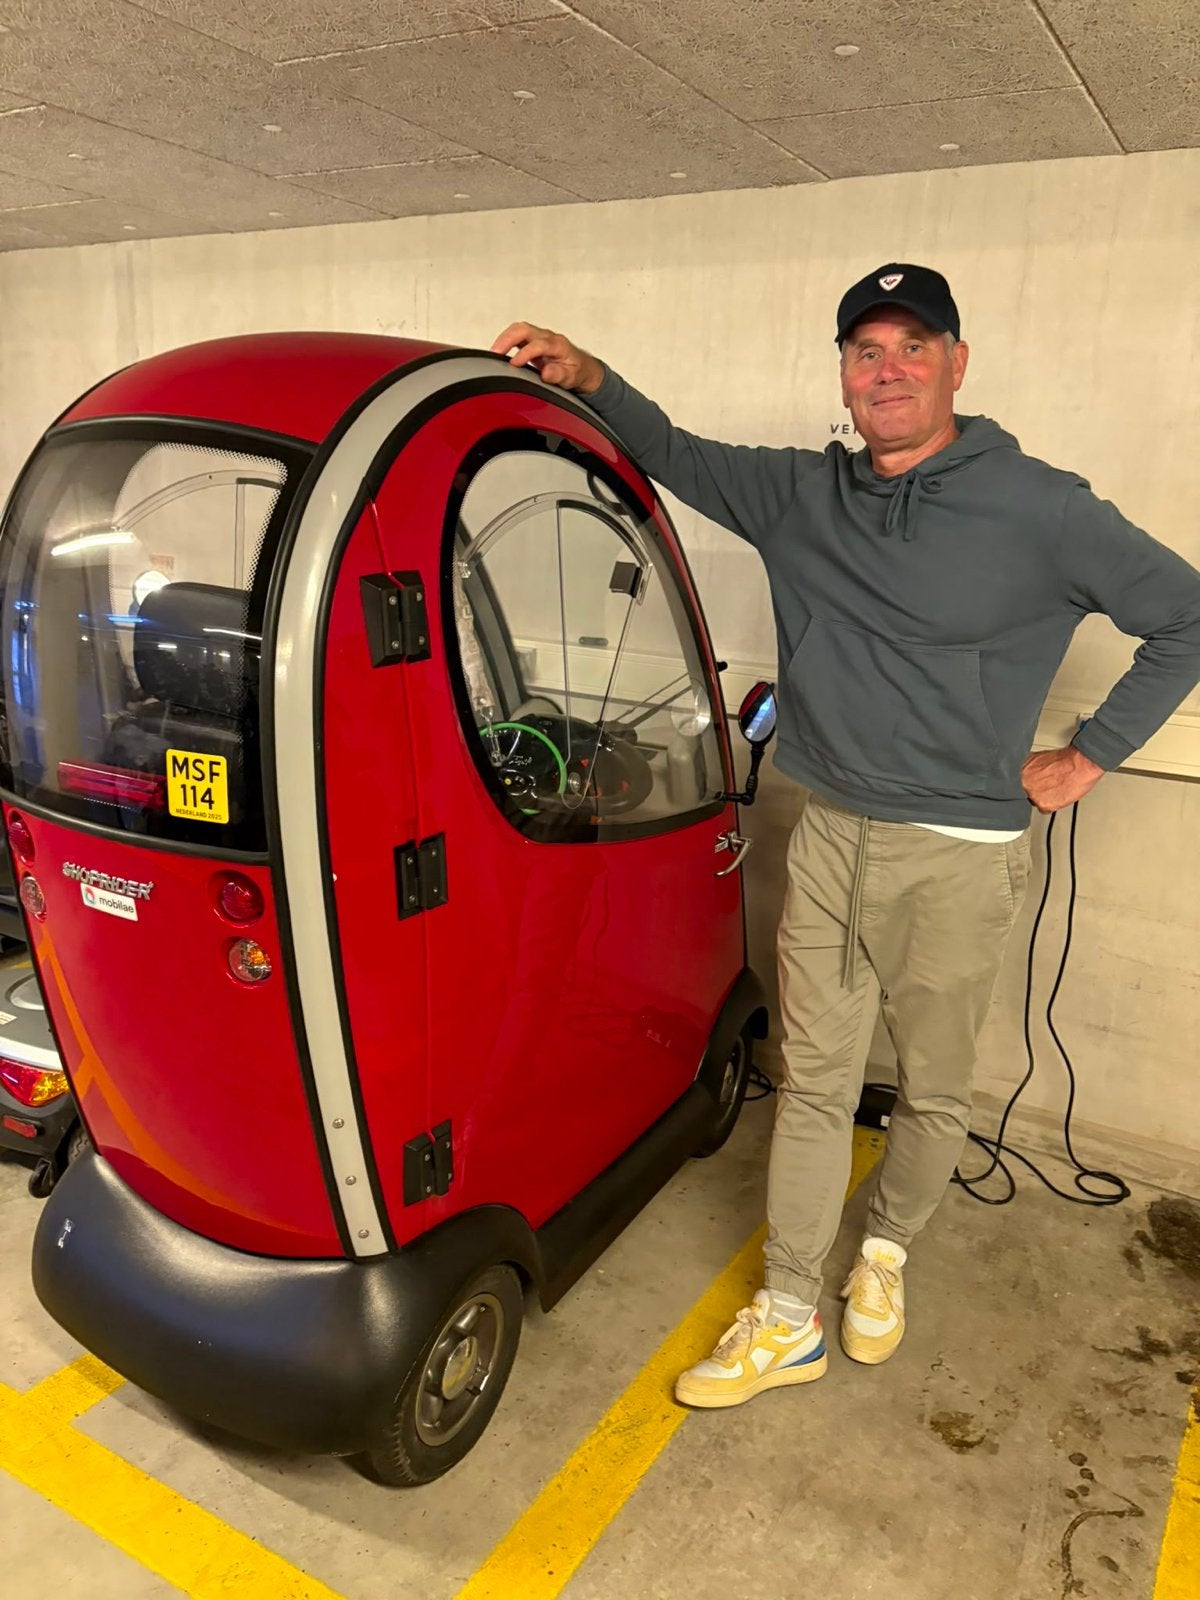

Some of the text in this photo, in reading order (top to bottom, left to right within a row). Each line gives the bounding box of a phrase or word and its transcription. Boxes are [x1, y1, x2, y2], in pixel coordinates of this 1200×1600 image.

[171, 754, 221, 783] MSF
[180, 784, 215, 810] 114
[175, 808, 208, 818] NEDERLAND
[62, 861, 151, 900] SHOPRIDER
[99, 897, 135, 914] mobilae
